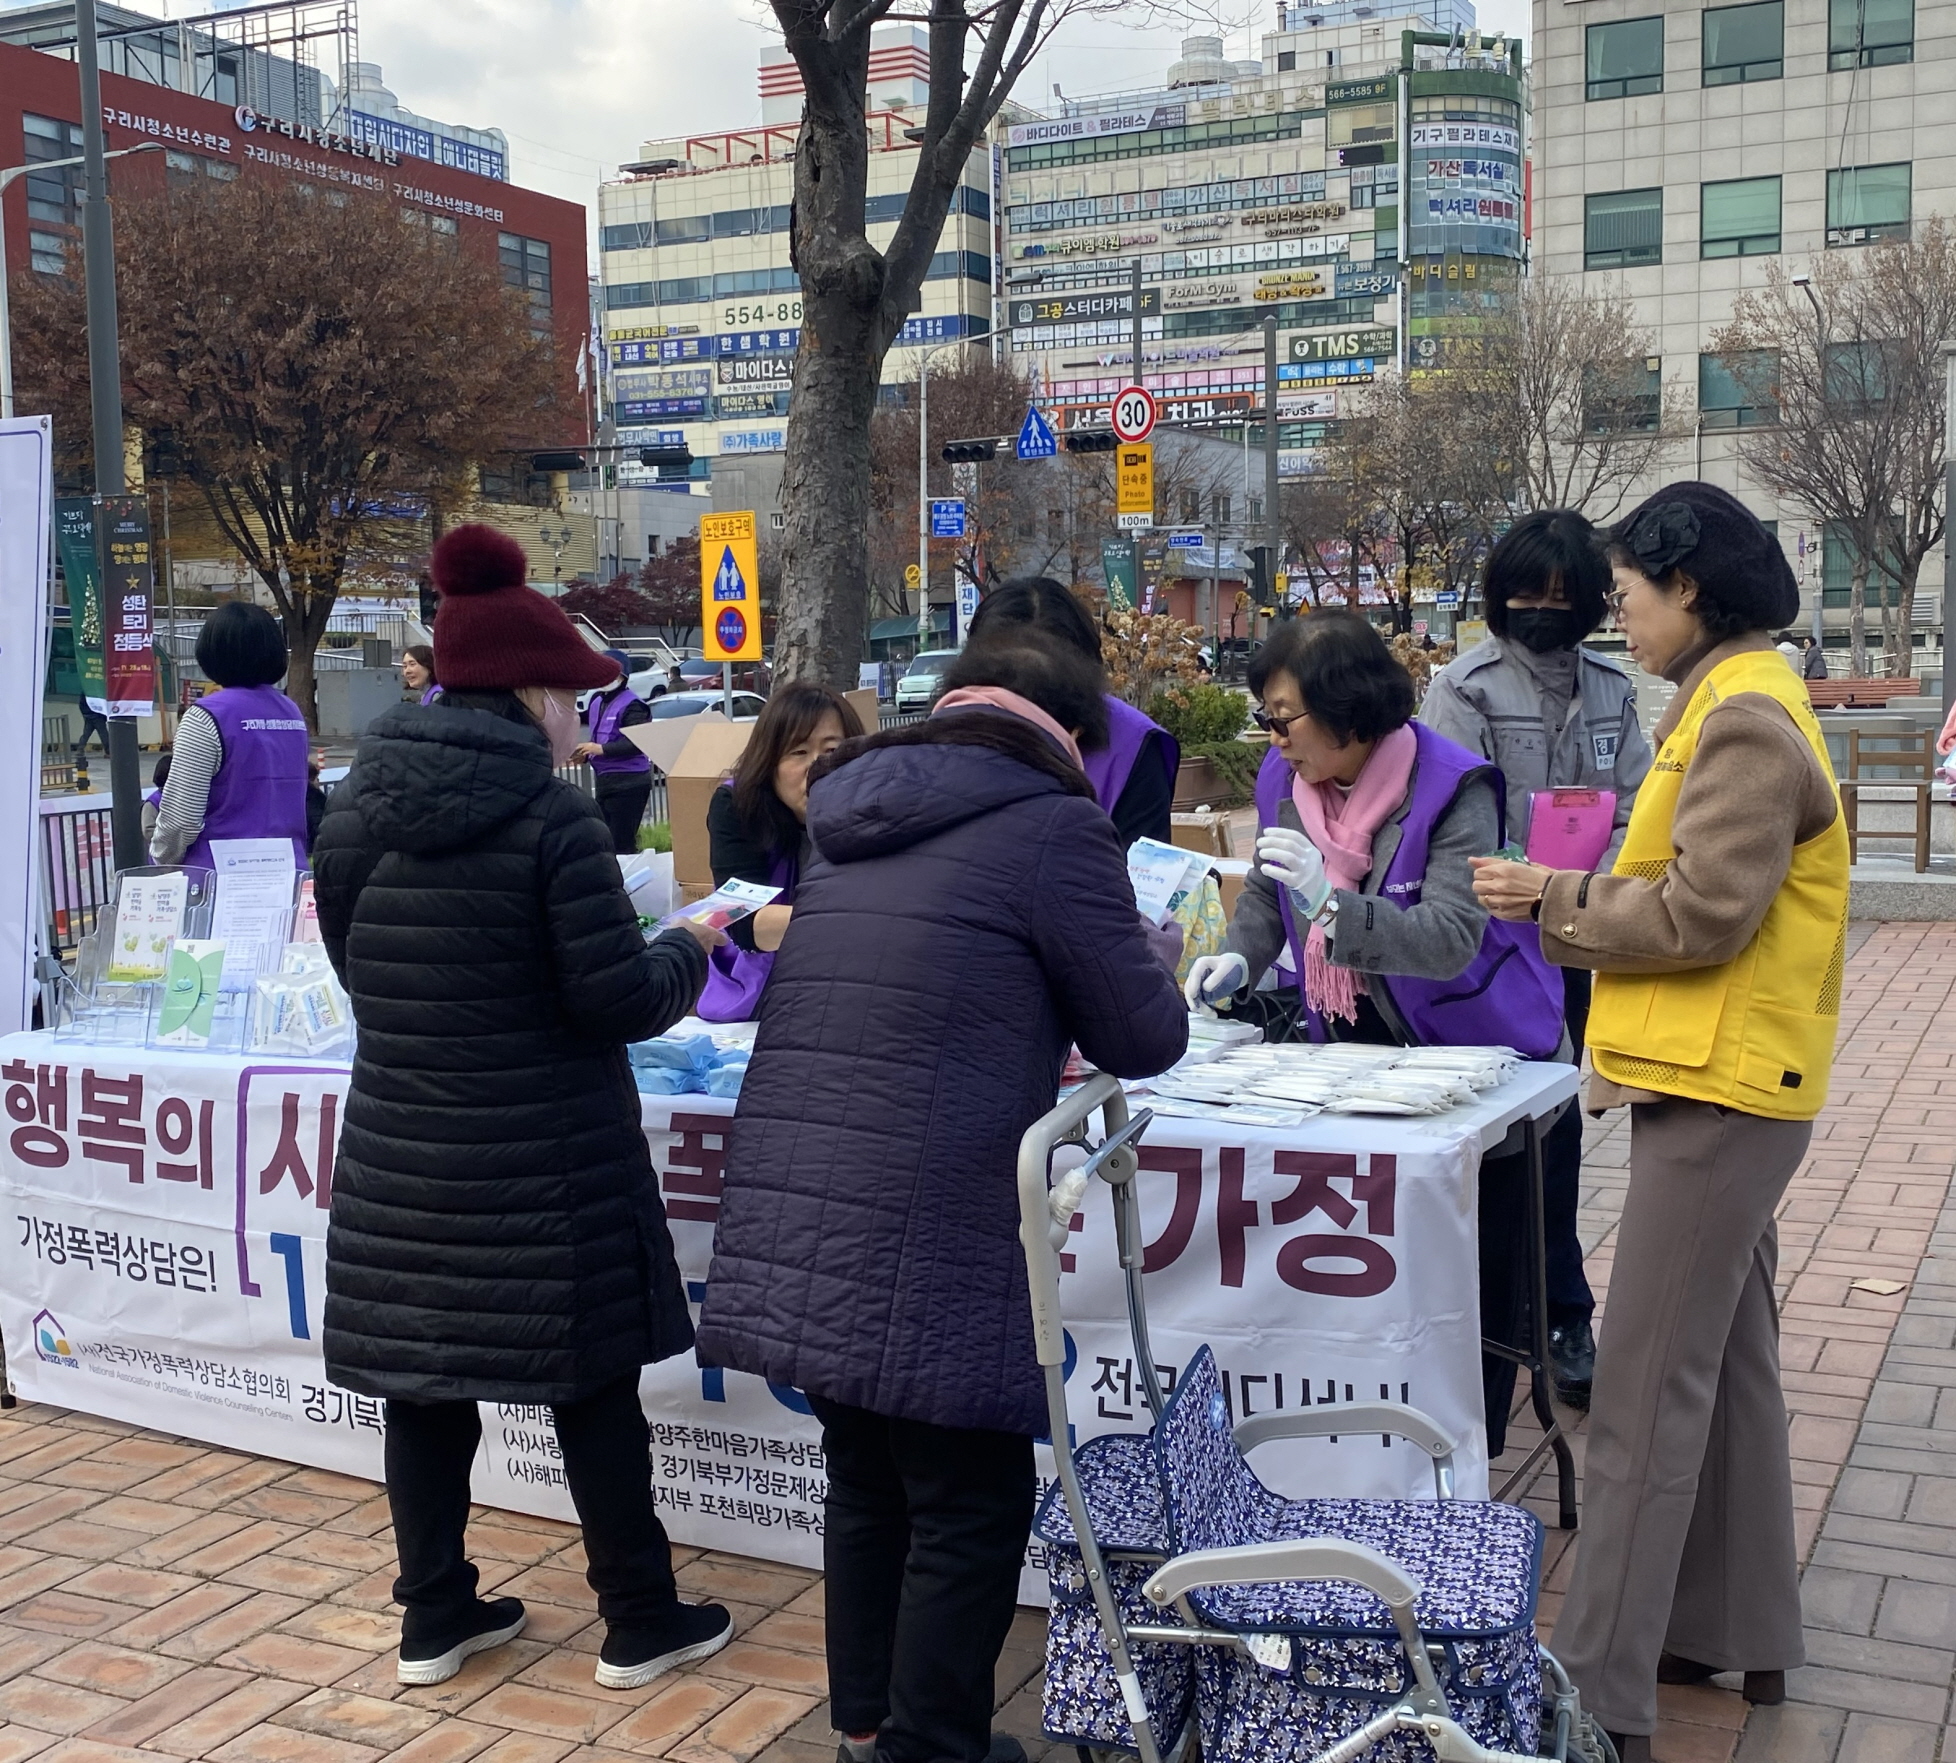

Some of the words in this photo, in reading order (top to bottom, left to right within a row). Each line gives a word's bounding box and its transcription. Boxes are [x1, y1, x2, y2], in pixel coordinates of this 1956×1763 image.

[104, 107, 231, 154] 구리시청소년수련관
[1099, 112, 1147, 132] 필라테스
[261, 115, 398, 167] 구리시청소년재단
[1413, 264, 1476, 280] 바디슬림
[1206, 282, 1237, 298] Gym
[1354, 275, 1396, 295] 보청기
[1036, 296, 1132, 319] 그공스터디카페
[1312, 333, 1360, 358] TMS
[735, 360, 787, 380] 마이다스
[1121, 400, 1145, 428] 30
[722, 431, 783, 449] (주)가족사랑
[1122, 473, 1148, 486] 단속중
[705, 518, 750, 538] 노인보호구역
[1121, 516, 1149, 526] 100m
[121, 594, 147, 612] 성탄
[122, 615, 148, 630] 트리
[1, 1058, 215, 1191] 행복의
[1135, 1145, 1397, 1298] 가정
[17, 1215, 217, 1293] 가정폭력상담은!
[88, 1363, 116, 1379] National
[117, 1372, 153, 1388] Association
[154, 1381, 161, 1390] of
[162, 1381, 193, 1399] Domestic
[194, 1389, 224, 1406] Violence
[224, 1397, 264, 1417] Counseling
[265, 1407, 294, 1422] Centers
[302, 1384, 385, 1435] 경기북
[661, 1454, 830, 1505] 경기북부가정문제상
